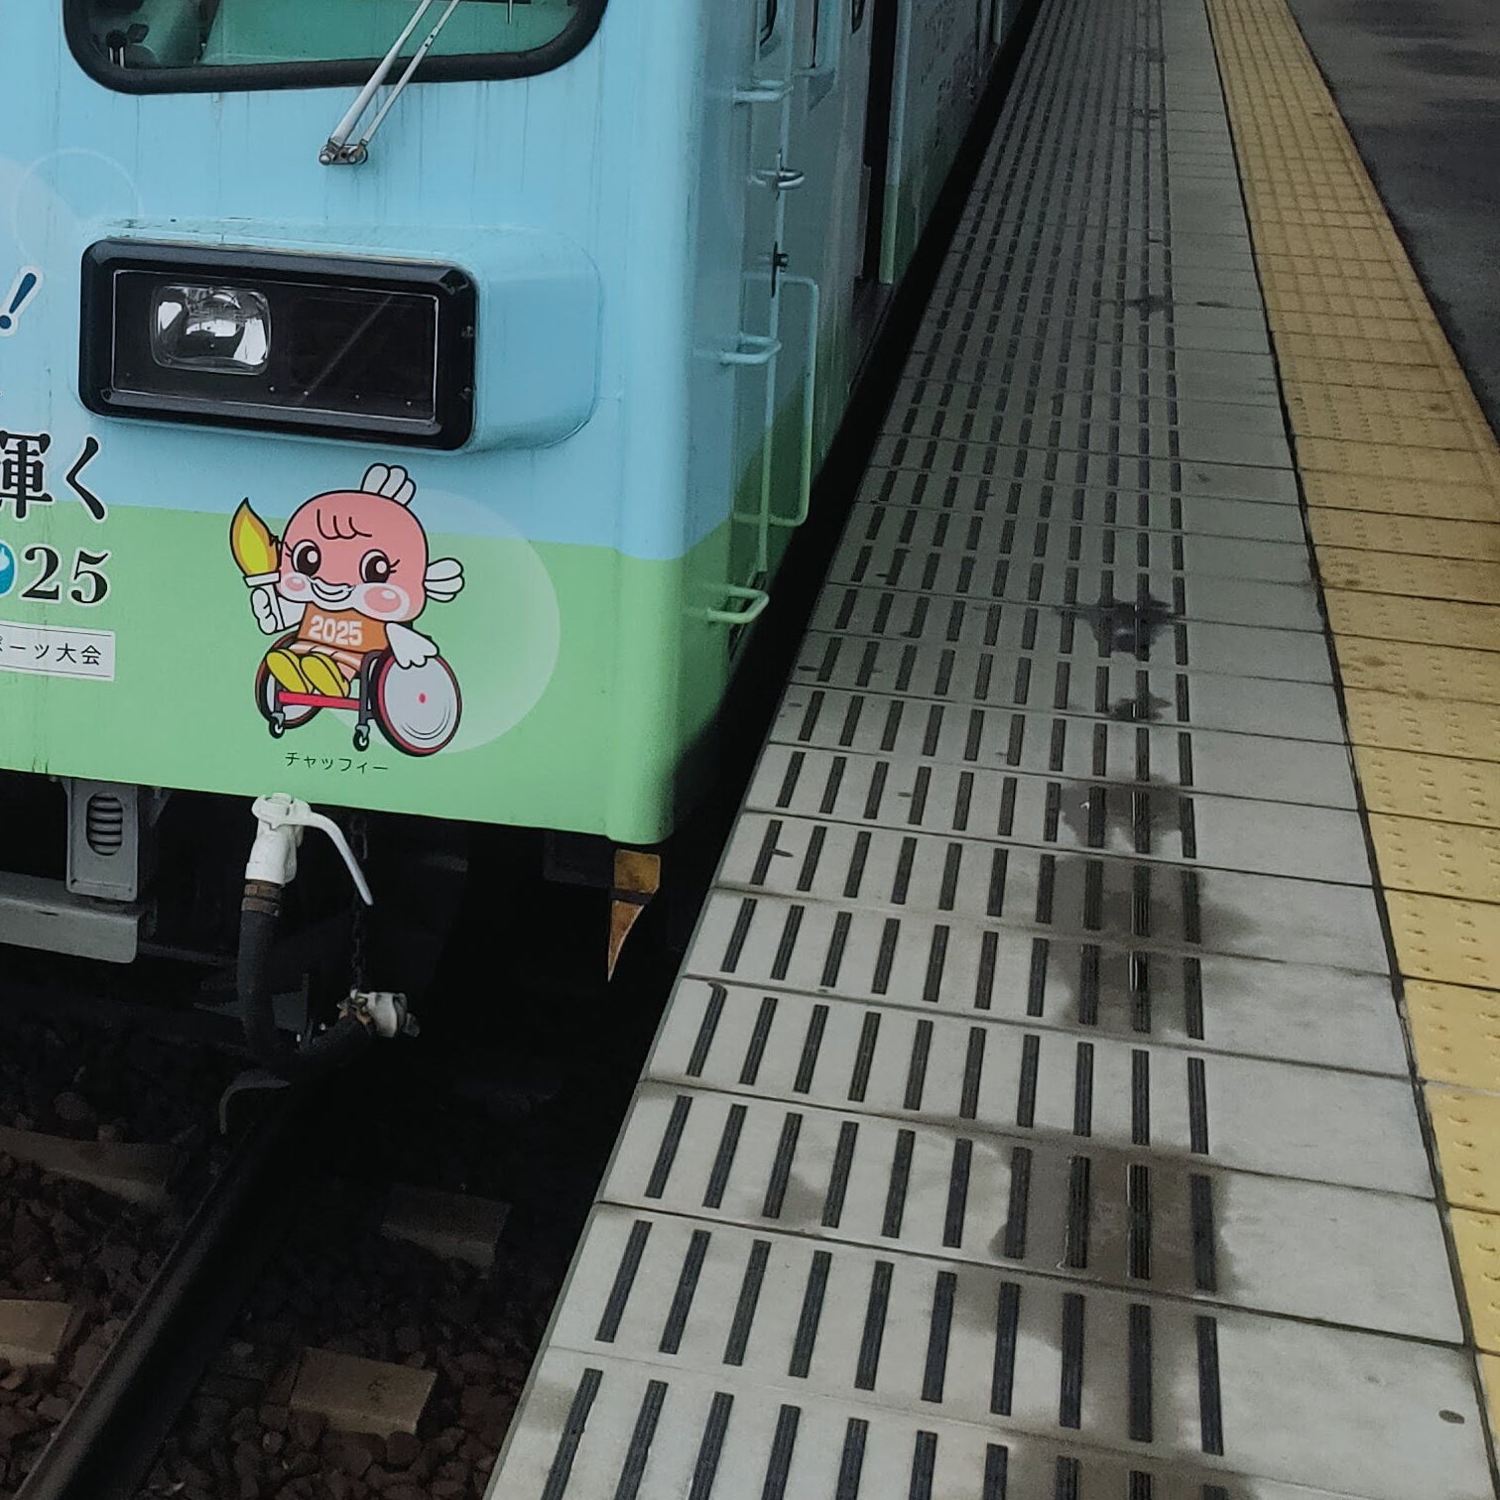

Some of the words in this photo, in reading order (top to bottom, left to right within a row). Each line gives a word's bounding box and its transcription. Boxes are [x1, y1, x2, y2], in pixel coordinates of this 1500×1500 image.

[307, 615, 363, 647] 2025
[284, 751, 389, 775] チャッフィー
